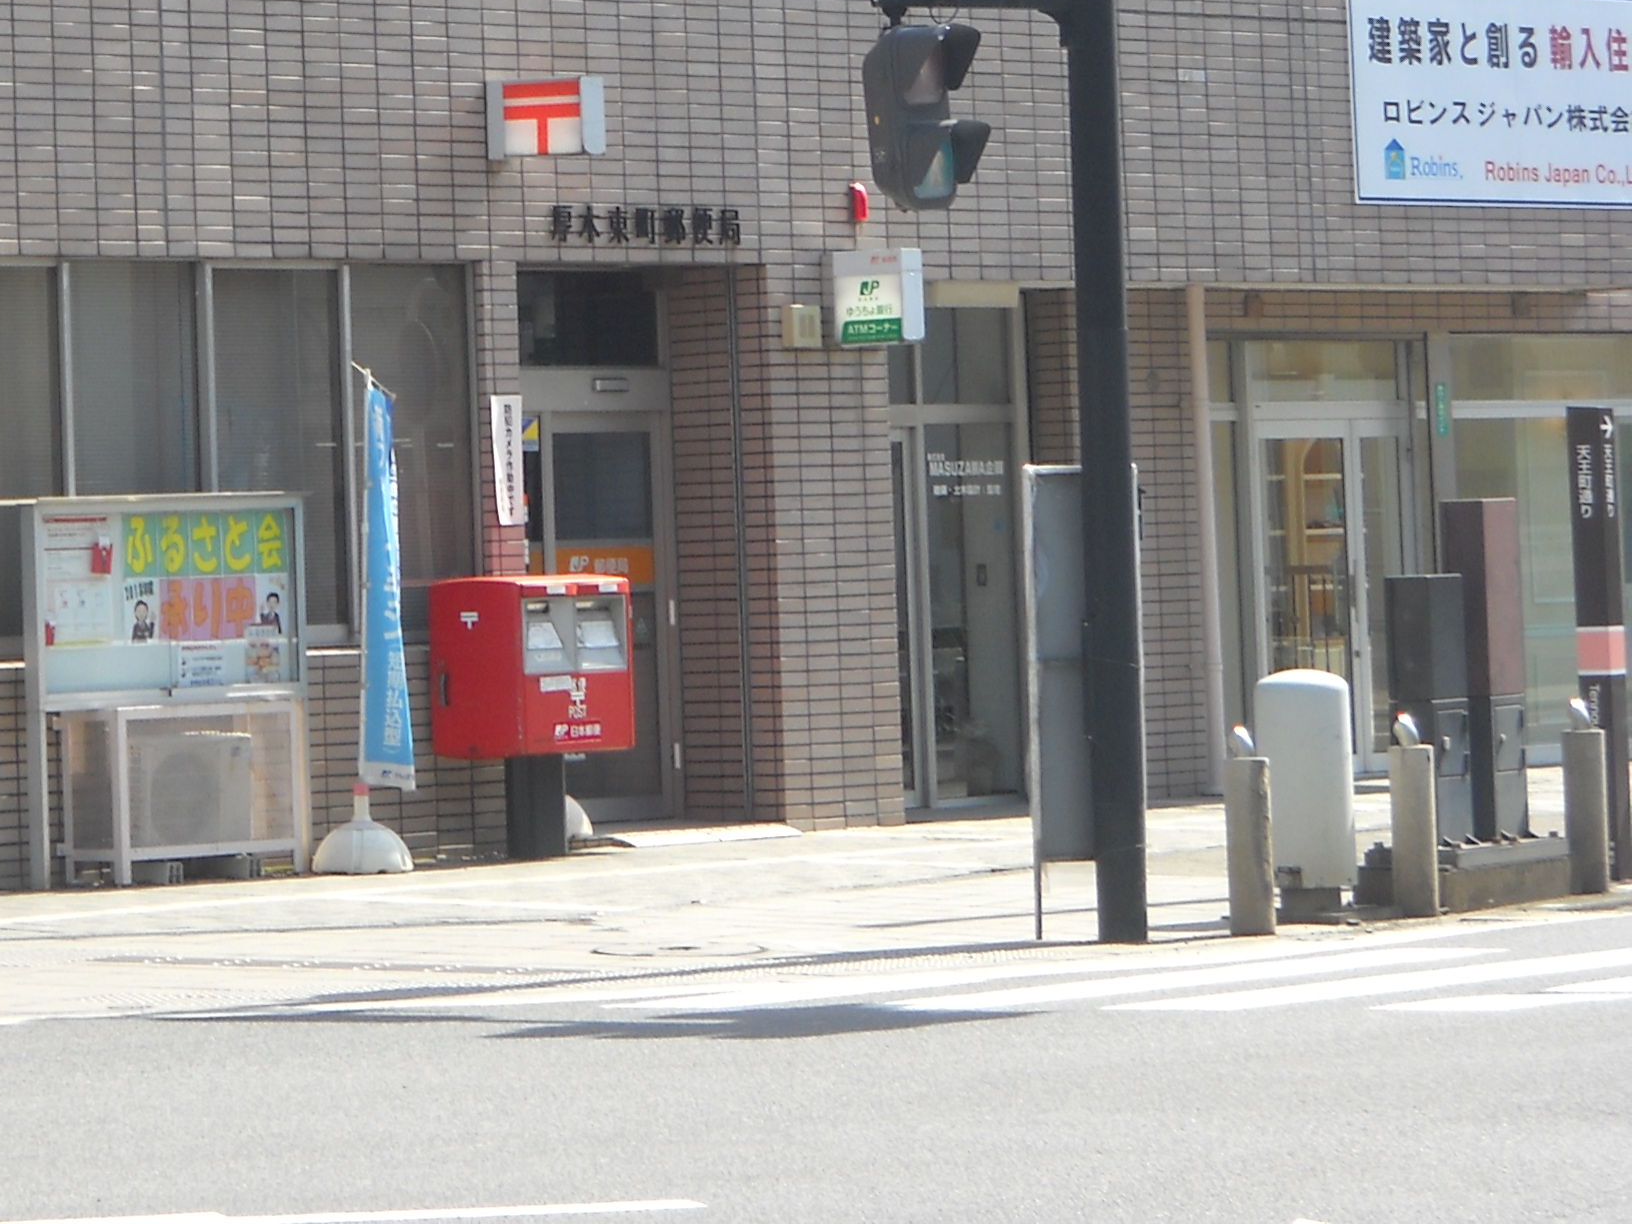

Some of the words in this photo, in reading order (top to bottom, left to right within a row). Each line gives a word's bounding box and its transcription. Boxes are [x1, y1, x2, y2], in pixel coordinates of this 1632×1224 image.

[1484, 160, 1540, 183] Robins
[1545, 163, 1590, 188] Japan
[551, 204, 741, 246] 厚木東町郵便局
[848, 323, 899, 335] ATMコーナー
[1576, 444, 1594, 519] 天王町通り
[126, 513, 282, 574] ふるさと会
[161, 577, 254, 640] 承り中
[569, 704, 587, 719] POST
[570, 723, 602, 738] 日本郵便
